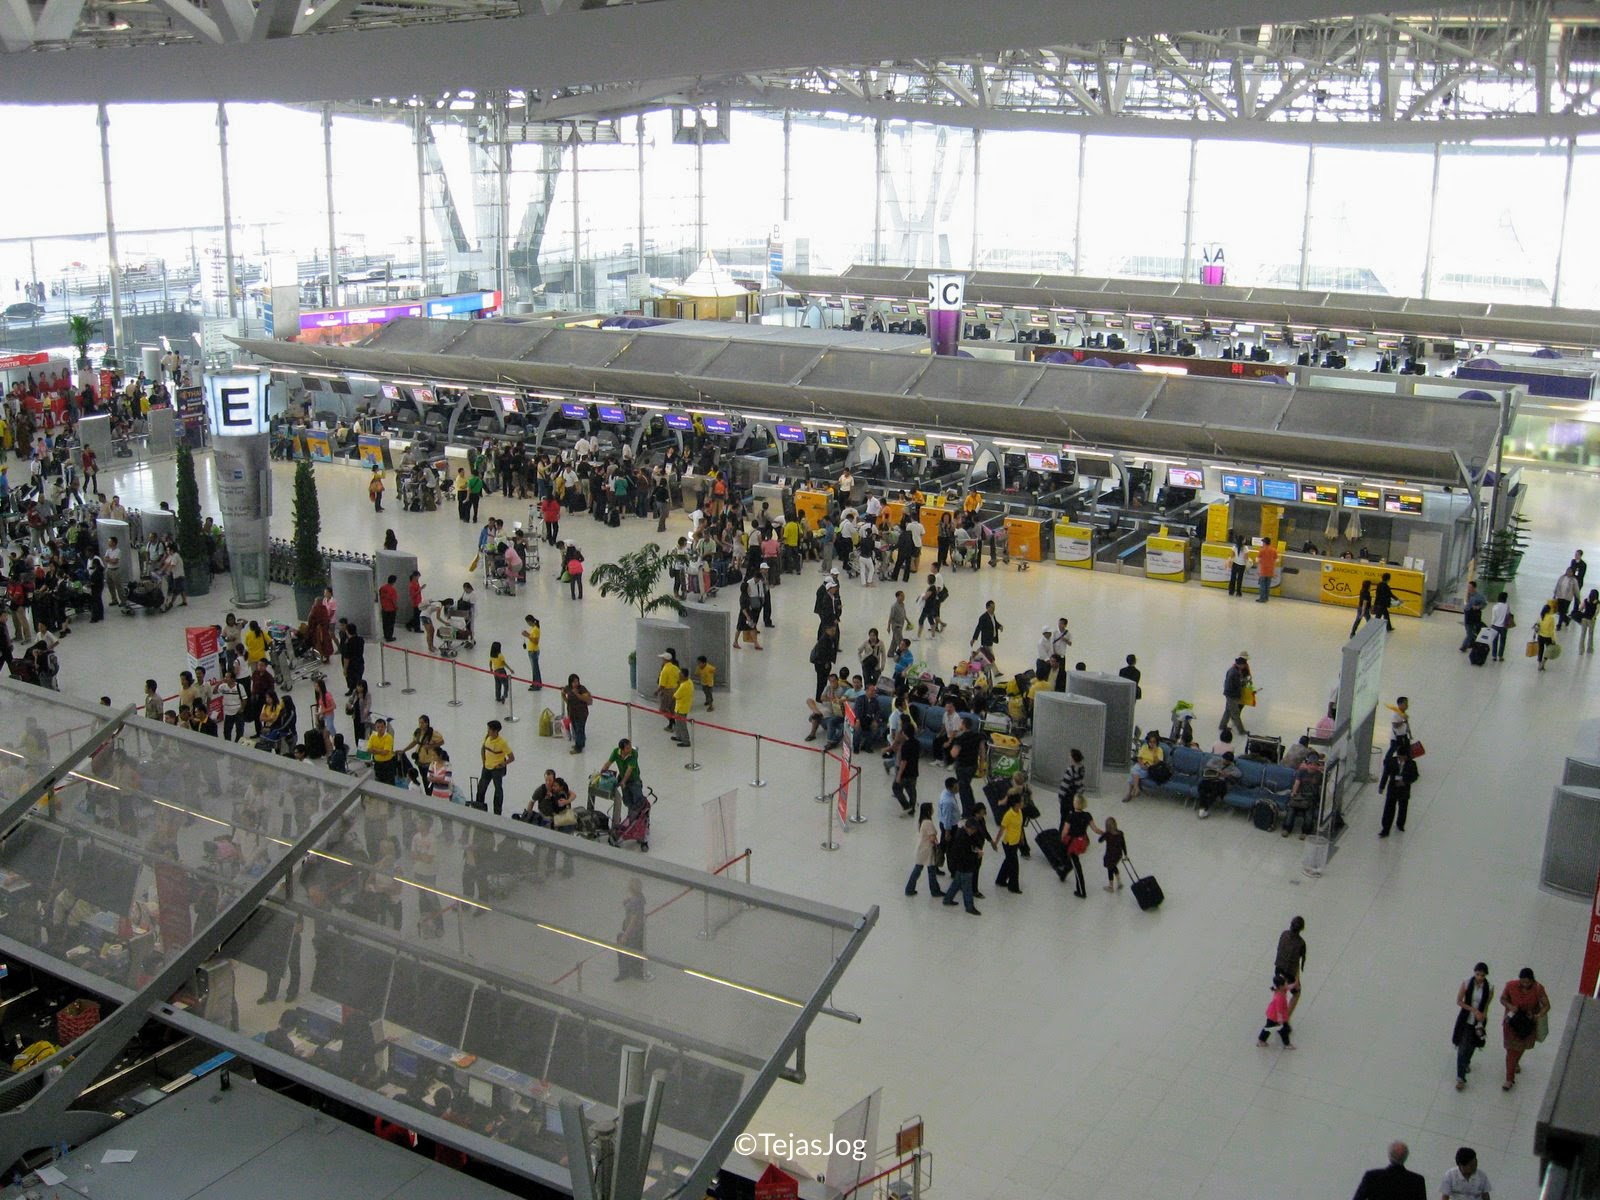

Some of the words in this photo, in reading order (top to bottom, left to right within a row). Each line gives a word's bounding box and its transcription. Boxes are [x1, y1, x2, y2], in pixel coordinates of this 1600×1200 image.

[942, 282, 959, 305] C
[221, 387, 252, 426] E
[1323, 578, 1352, 593] SGA
